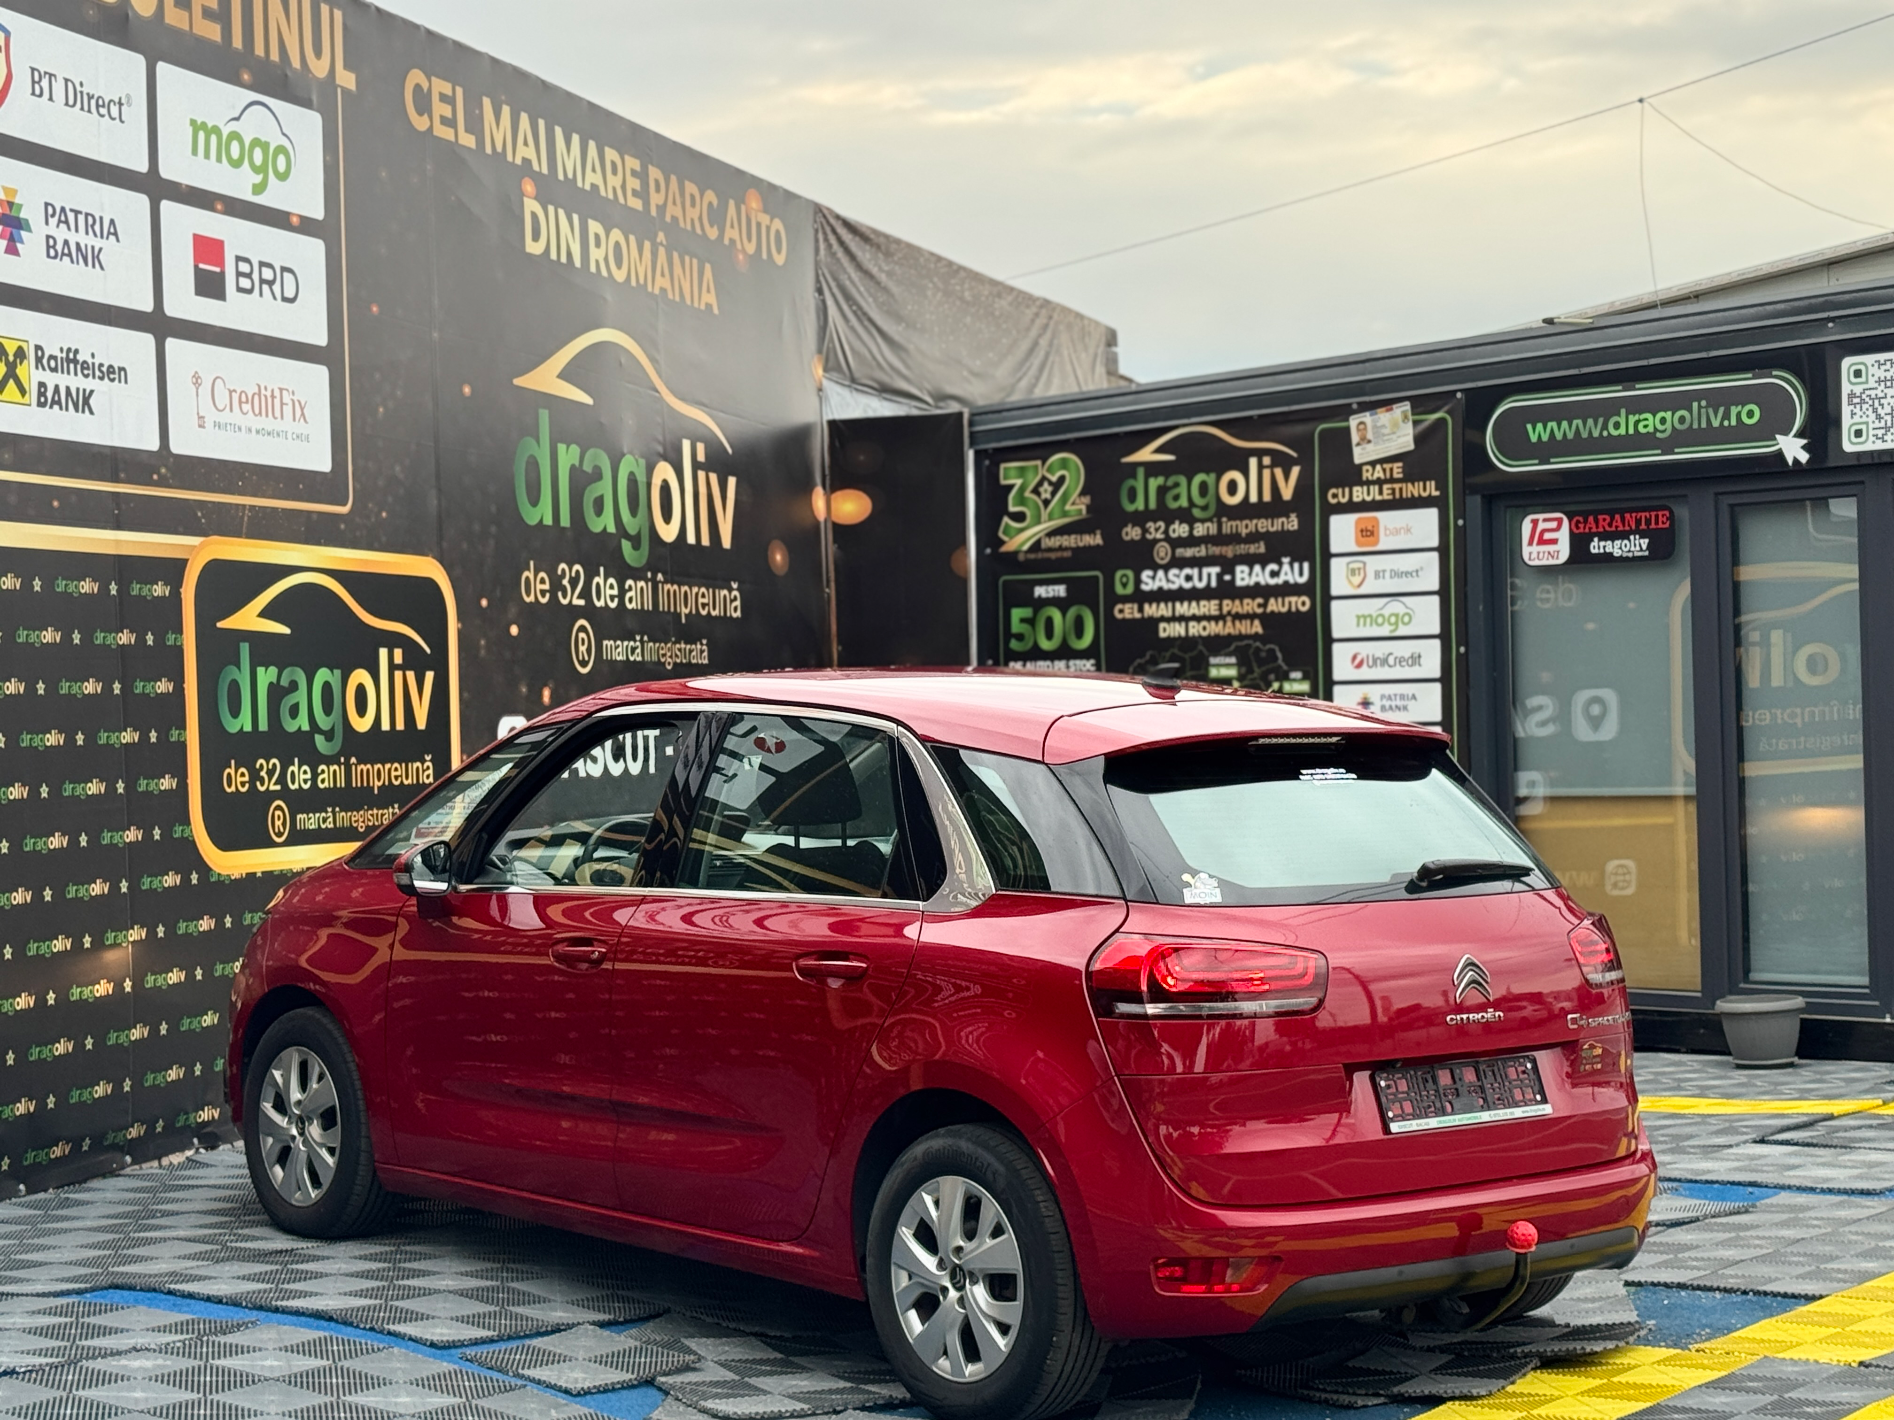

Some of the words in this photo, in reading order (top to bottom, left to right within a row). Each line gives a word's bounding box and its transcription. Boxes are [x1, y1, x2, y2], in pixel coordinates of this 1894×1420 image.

[29, 65, 57, 103] BT
[190, 117, 292, 196] mogo
[403, 68, 476, 150] CEL
[482, 95, 548, 175] MAI
[554, 124, 643, 211] MARE
[648, 164, 719, 242] PARC
[724, 198, 788, 267] AUTO
[44, 201, 121, 243] PATRIA
[45, 235, 105, 271] BANK
[523, 194, 582, 269] DIN
[587, 218, 720, 316] ROMÂNIA
[234, 254, 300, 304] BRD
[34, 344, 129, 385] Raiffeisen
[36, 382, 95, 416] BANK
[210, 375, 309, 424] CreditFix
[213, 420, 242, 433] PRIETEN
[245, 425, 252, 434] IN
[255, 427, 288, 441] MOMENTE
[1526, 400, 1761, 443] www.dragoliv.ro
[1362, 462, 1404, 481] RATE
[514, 408, 737, 568] dragoliv
[1119, 456, 1300, 518] dragoliv
[1327, 488, 1350, 504] CU
[1352, 480, 1440, 502] BULETINUL
[1121, 523, 1142, 541] de
[1145, 521, 1166, 539] 32
[1169, 518, 1190, 538] de
[1193, 518, 1217, 537] ani
[1221, 513, 1299, 538] împreună
[1359, 525, 1375, 538] tbi
[1384, 523, 1413, 537] bank
[1527, 517, 1564, 547] 12
[1571, 510, 1671, 534] GARANTIE
[1528, 550, 1560, 562] LUNI
[1590, 534, 1649, 557] dragoliv
[55, 577, 99, 597] dragoliv
[130, 580, 170, 600] dragoliv
[1140, 566, 1221, 591] SASCUT
[1235, 557, 1310, 587] BACĂU
[1374, 569, 1387, 580] BT
[520, 560, 550, 604] de
[557, 562, 585, 606] 32
[591, 566, 619, 609] de
[625, 572, 652, 612] ani
[657, 573, 742, 624] împreună
[1033, 584, 1067, 598] PESTE
[1113, 603, 1142, 619] CEL
[1143, 601, 1172, 618] MAI
[1175, 600, 1220, 617] MARE
[1222, 598, 1264, 615] PARC
[1266, 595, 1311, 613] AUTO
[16, 626, 61, 647] dragoliv
[94, 628, 136, 648] dragoliv
[1008, 604, 1095, 651] 500
[1158, 621, 1186, 638] DIN
[1188, 616, 1263, 637] ROMÂNIA
[1355, 612, 1413, 634] mogo
[602, 635, 642, 662] marcă
[643, 635, 709, 670] înregistrată
[1069, 659, 1096, 671] STOC
[1366, 652, 1422, 669] UniCredit
[58, 678, 102, 698] dragoliv
[133, 677, 174, 697] dragoliv
[216, 642, 435, 756] dragoliv
[1380, 693, 1417, 703] PATRIA
[1380, 704, 1409, 713] BANK
[19, 729, 65, 750] dragoliv
[97, 727, 139, 748] dragoliv
[62, 778, 106, 799] dragoliv
[137, 774, 177, 794] dragoliv
[223, 759, 249, 793] de
[256, 757, 282, 791] 32
[287, 757, 312, 790] de
[317, 757, 345, 789] ani
[351, 754, 434, 795] împreună
[296, 807, 334, 830] marcă
[23, 831, 68, 853] dragoliv
[100, 825, 143, 847] dragoliv
[65, 878, 110, 900] dragoliv
[140, 871, 181, 891] dragoliv
[26, 935, 72, 957] dragoliv
[104, 925, 147, 946] dragoliv
[176, 914, 216, 936] dragoliv
[69, 979, 114, 1002] dragoliv
[144, 968, 186, 989] dragoliv
[214, 957, 244, 978] drago
[28, 1037, 74, 1062] dragoliv
[106, 1024, 149, 1047] dragoliv
[180, 1010, 219, 1032] dragoliv
[69, 1080, 113, 1104] dragoliv
[143, 1064, 185, 1087] dragoliv
[23, 1140, 72, 1166] dragoliv
[103, 1122, 146, 1146] dragoliv
[175, 1105, 220, 1128] dragoliv
